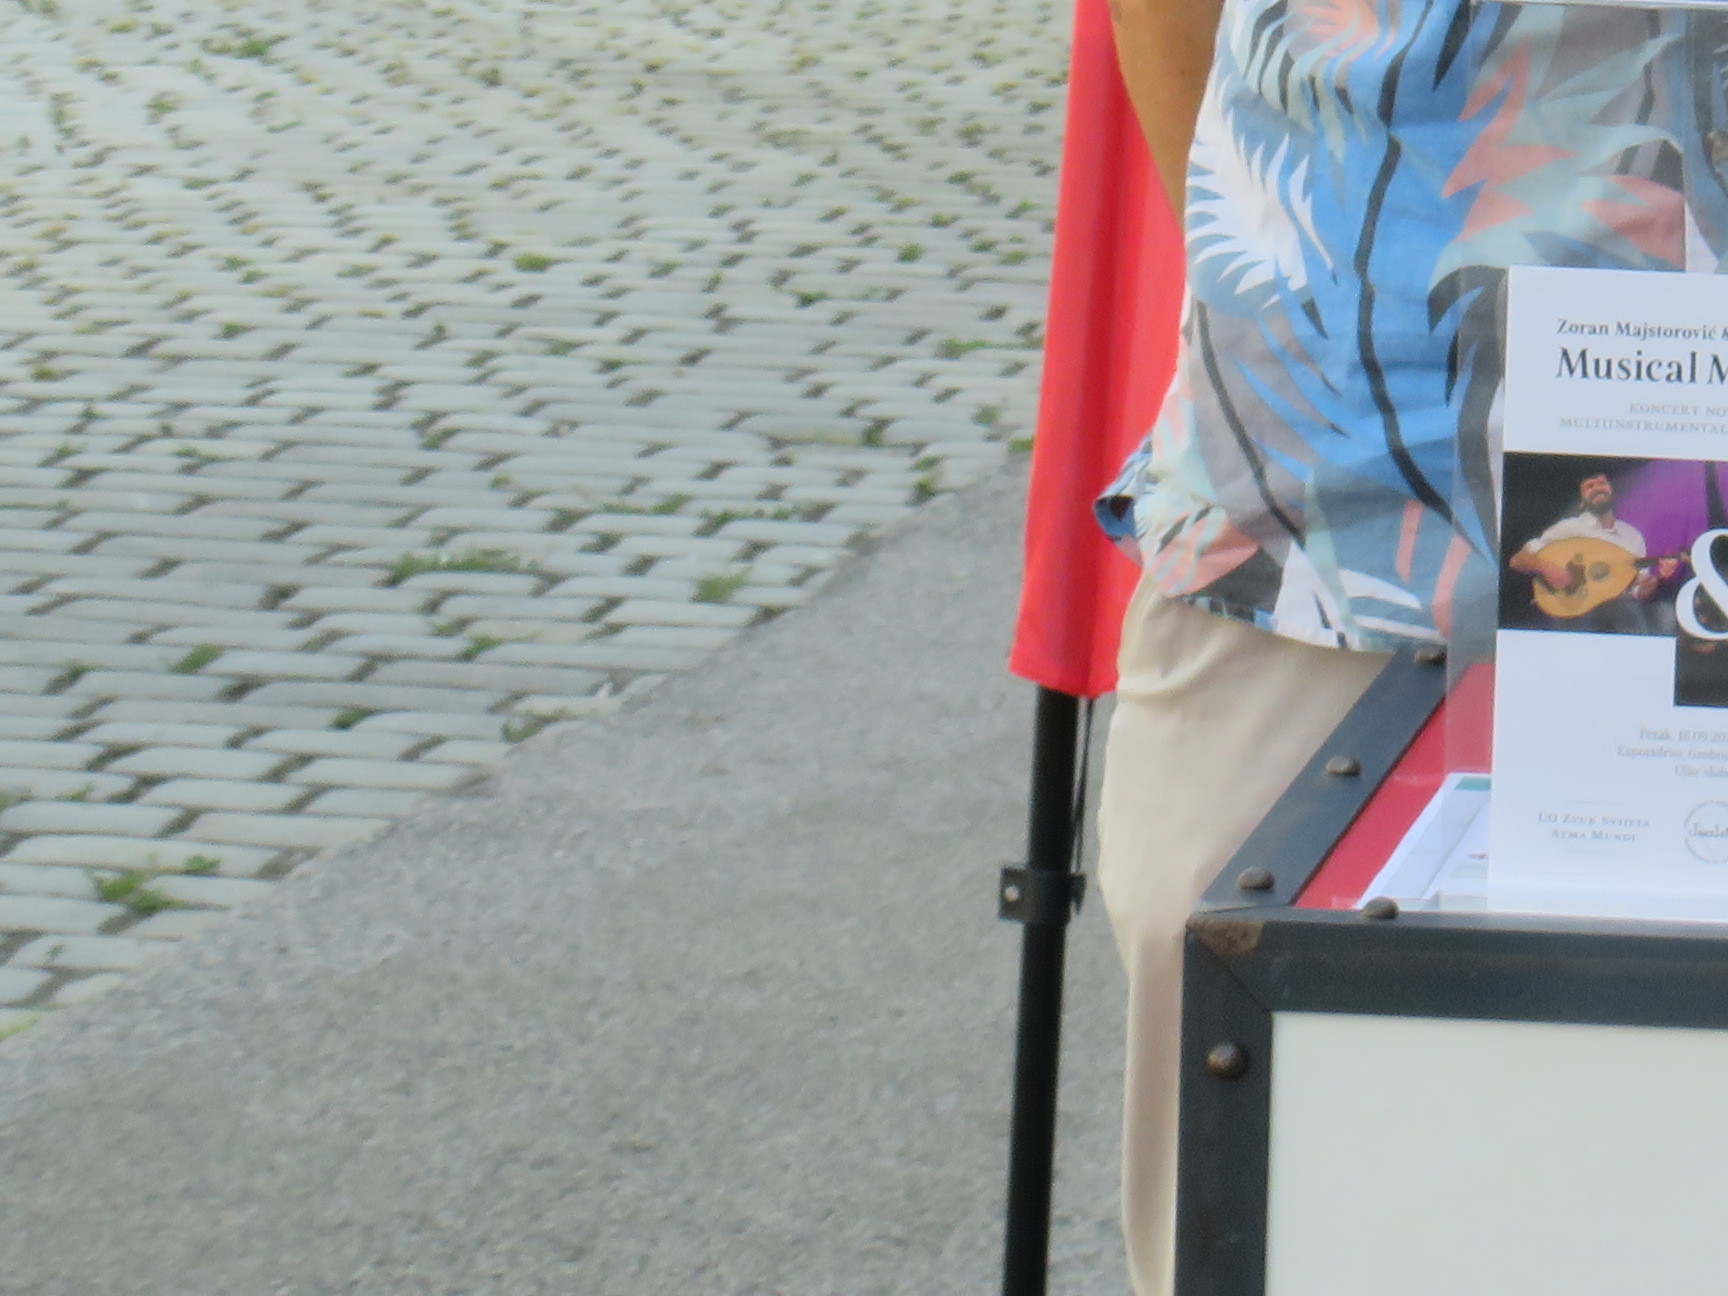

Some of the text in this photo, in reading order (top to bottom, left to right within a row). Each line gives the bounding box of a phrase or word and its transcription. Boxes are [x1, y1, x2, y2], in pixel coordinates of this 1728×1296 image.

[1556, 317, 1610, 337] Zoran
[1614, 319, 1717, 343] Majstorović
[1555, 346, 1697, 386] Musical
[1628, 402, 1700, 418] KONCERT
